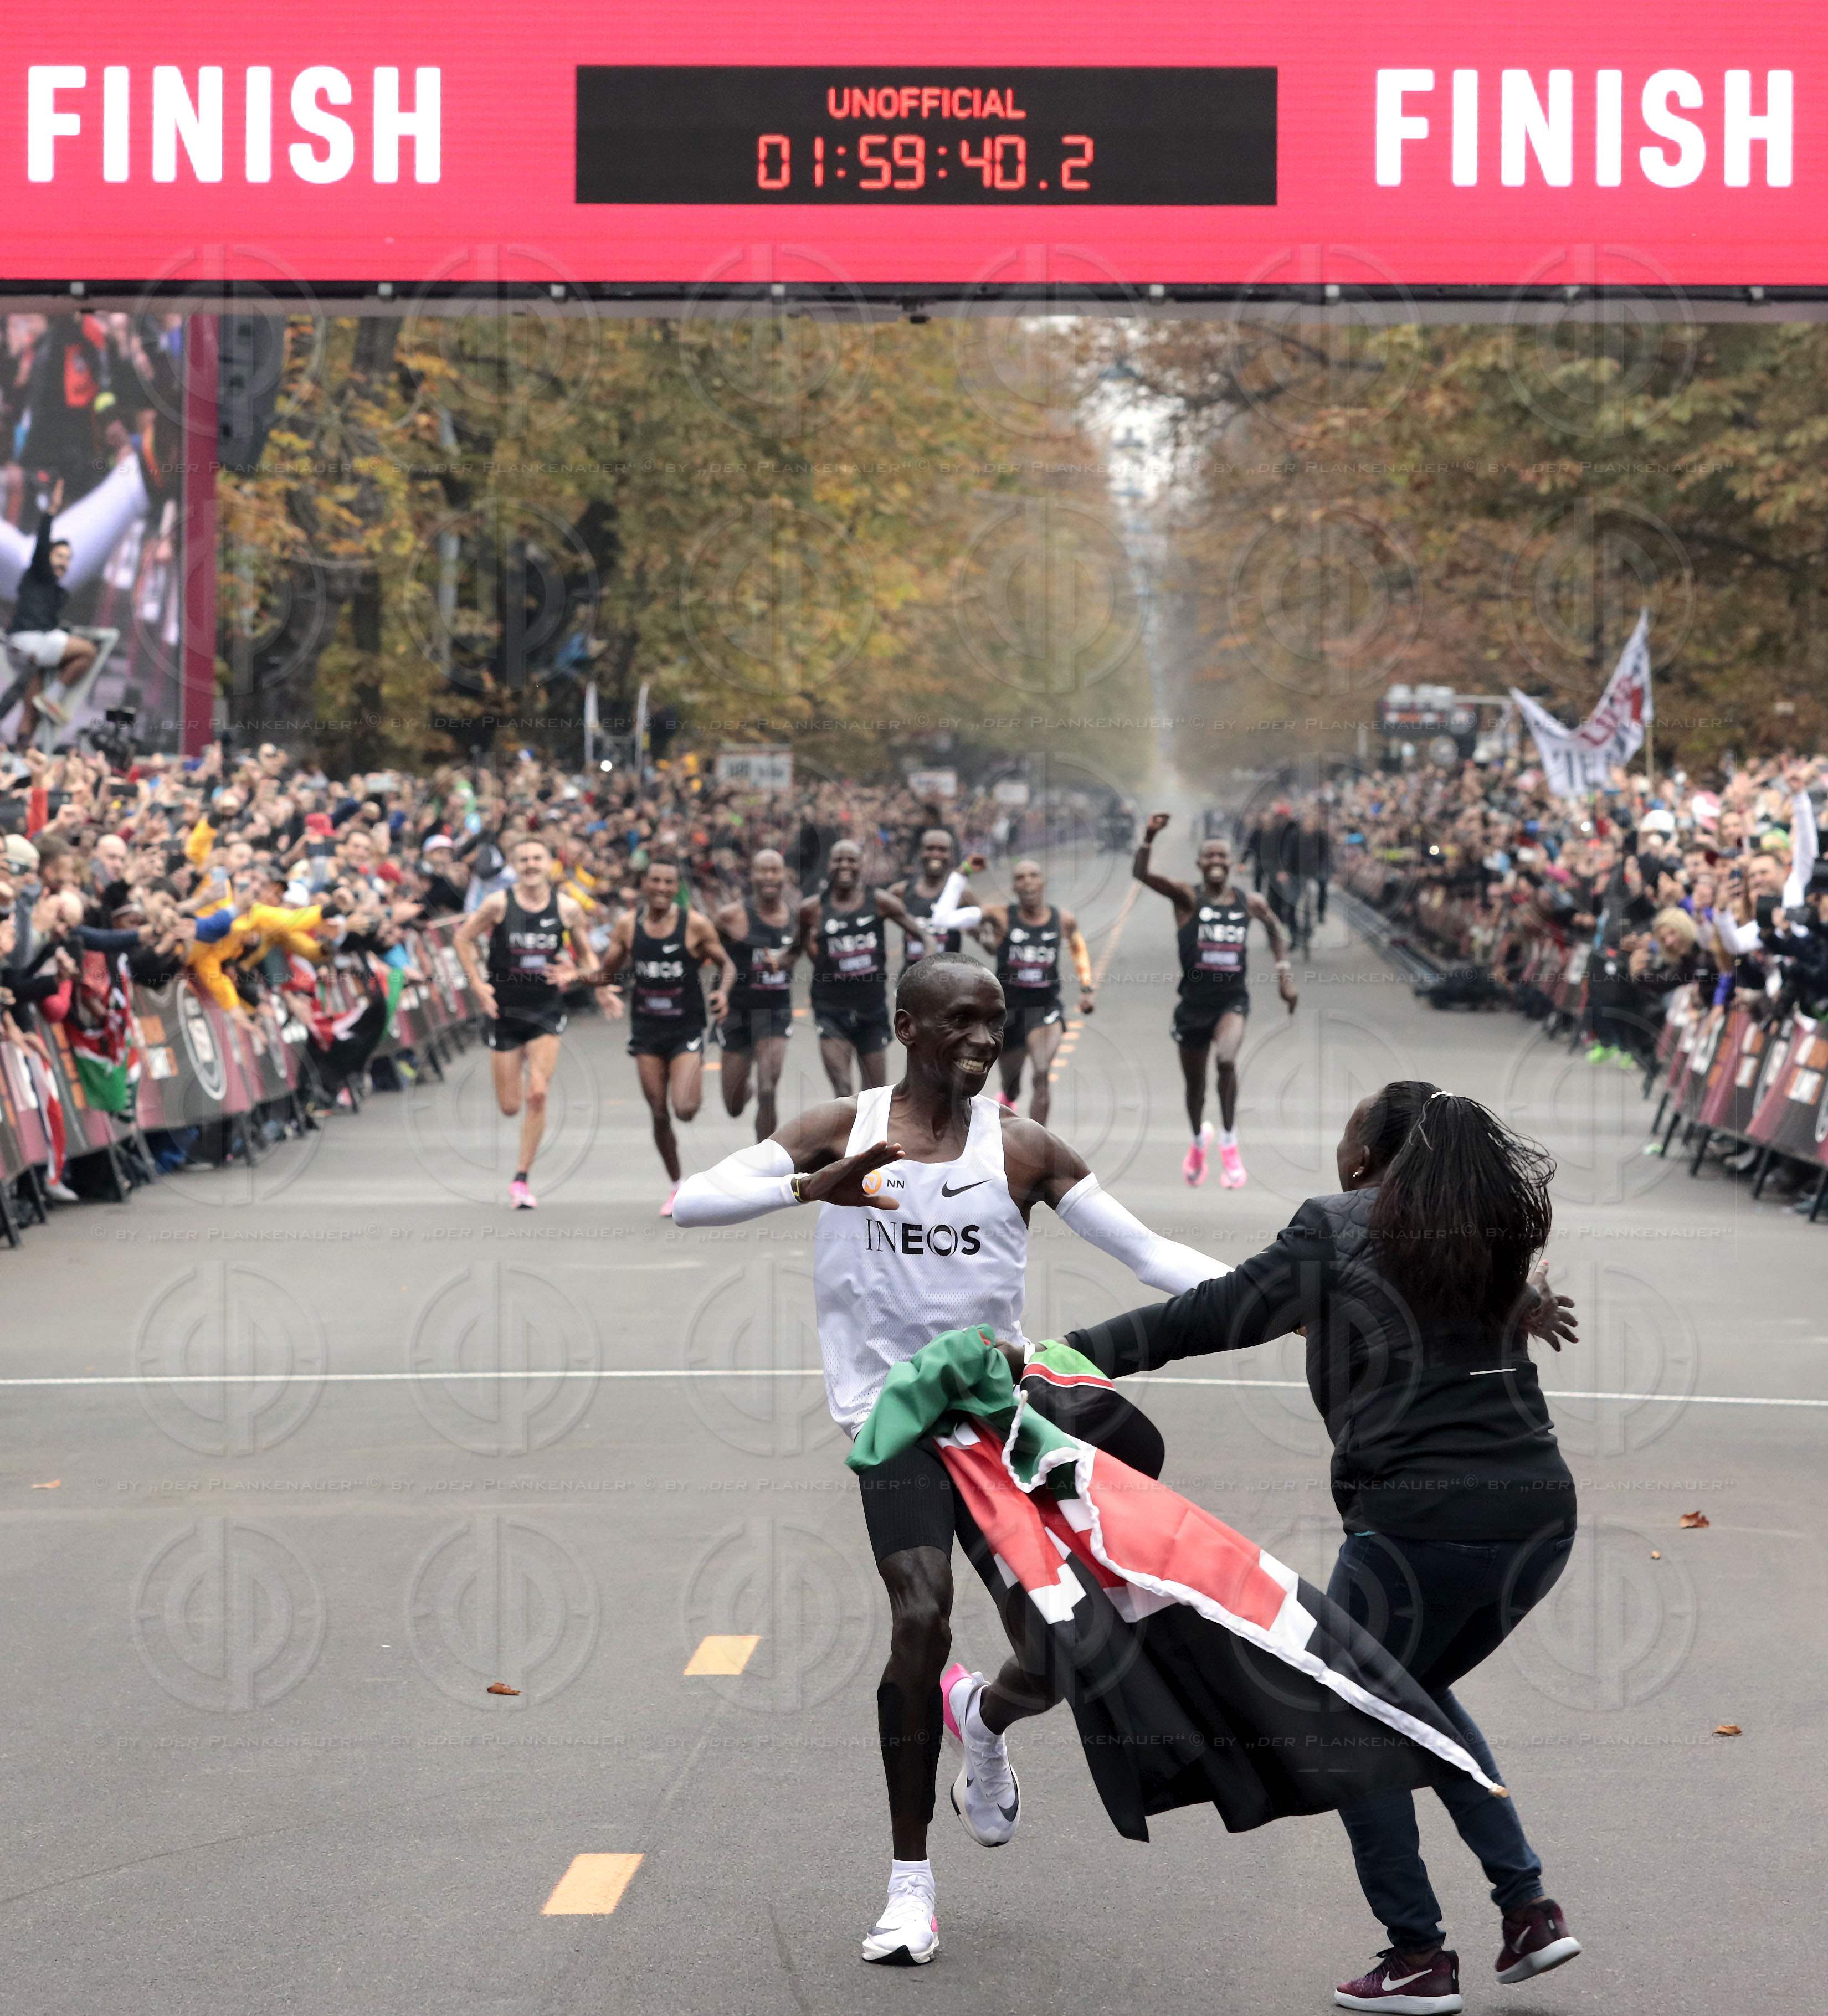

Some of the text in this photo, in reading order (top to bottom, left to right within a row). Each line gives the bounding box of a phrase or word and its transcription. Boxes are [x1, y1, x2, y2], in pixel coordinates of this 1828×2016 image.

[28, 66, 441, 184] FINISH
[828, 86, 1026, 120] UNOFFICIAL
[1376, 69, 1793, 188] FINISH
[758, 135, 1093, 190] 01:59:40.2
[887, 1179, 905, 1189] NN
[866, 1218, 982, 1257] INEOS
